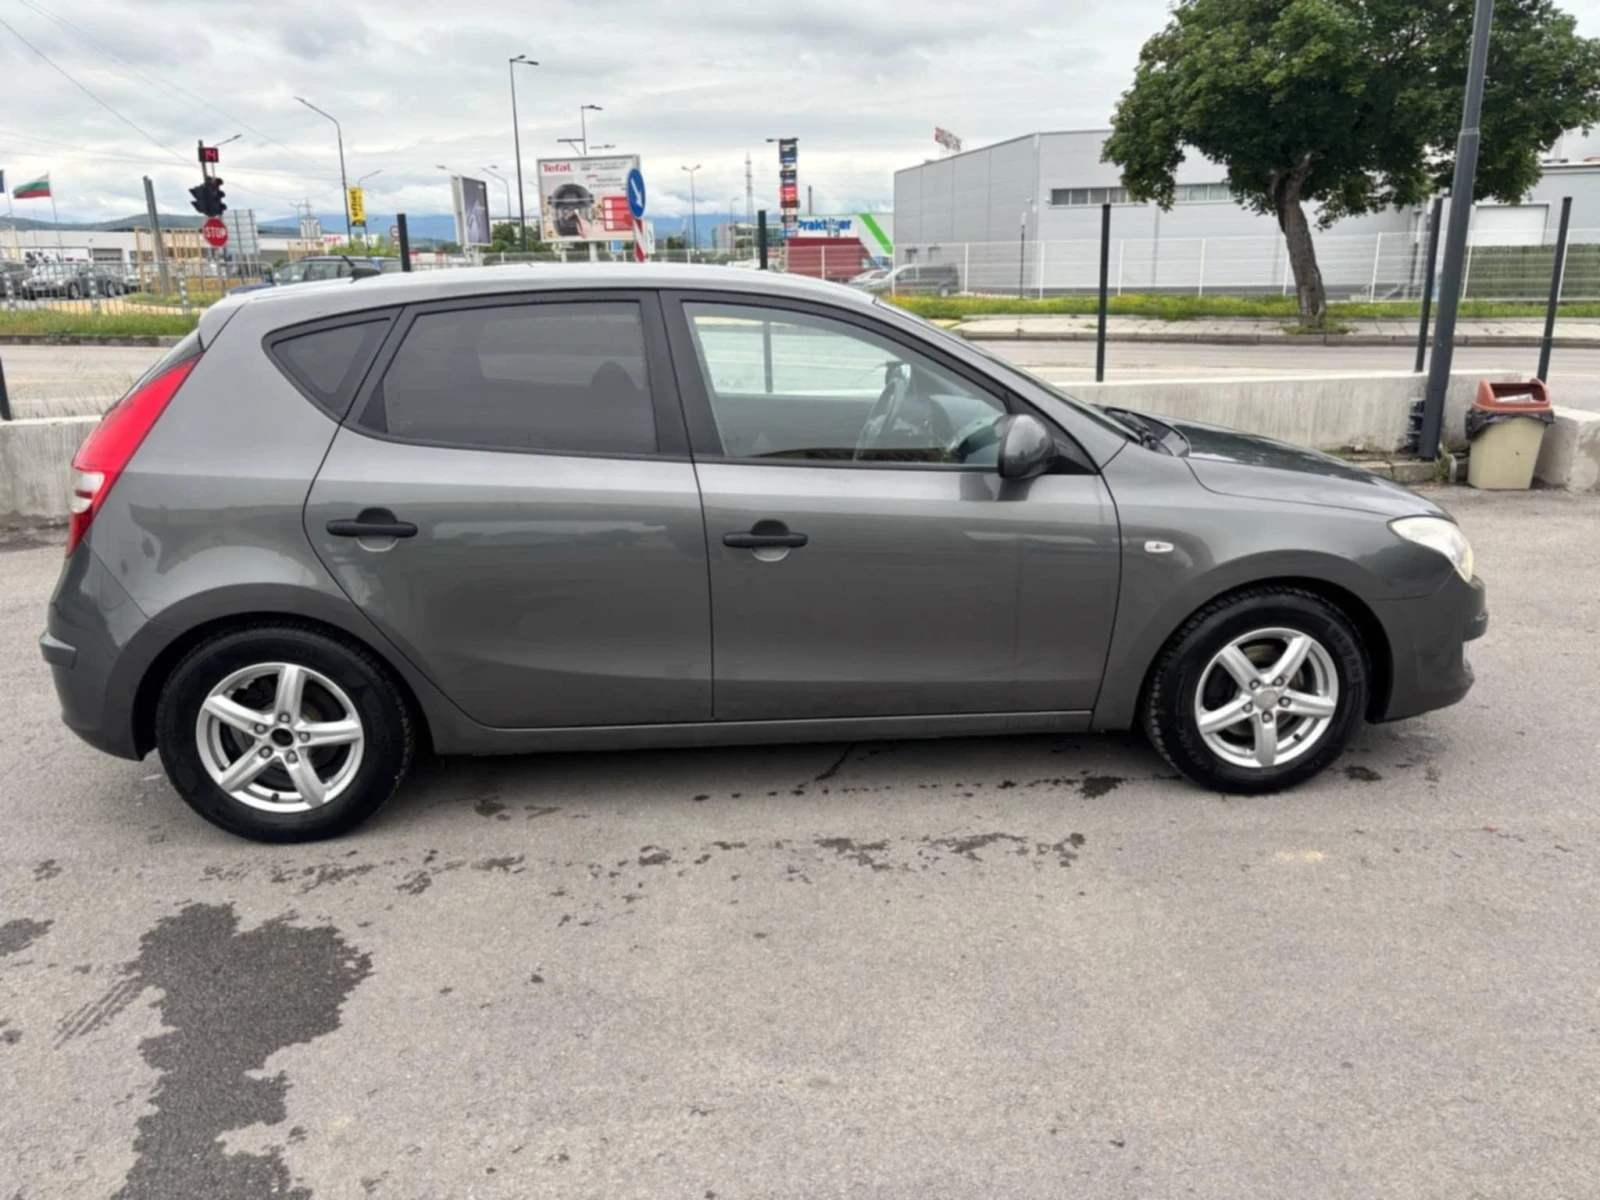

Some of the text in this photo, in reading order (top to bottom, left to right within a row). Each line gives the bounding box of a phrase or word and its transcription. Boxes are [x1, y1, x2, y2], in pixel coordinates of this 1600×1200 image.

[543, 163, 571, 173] Tefal
[798, 218, 852, 231] Prakter
[204, 226, 227, 238] STOP
